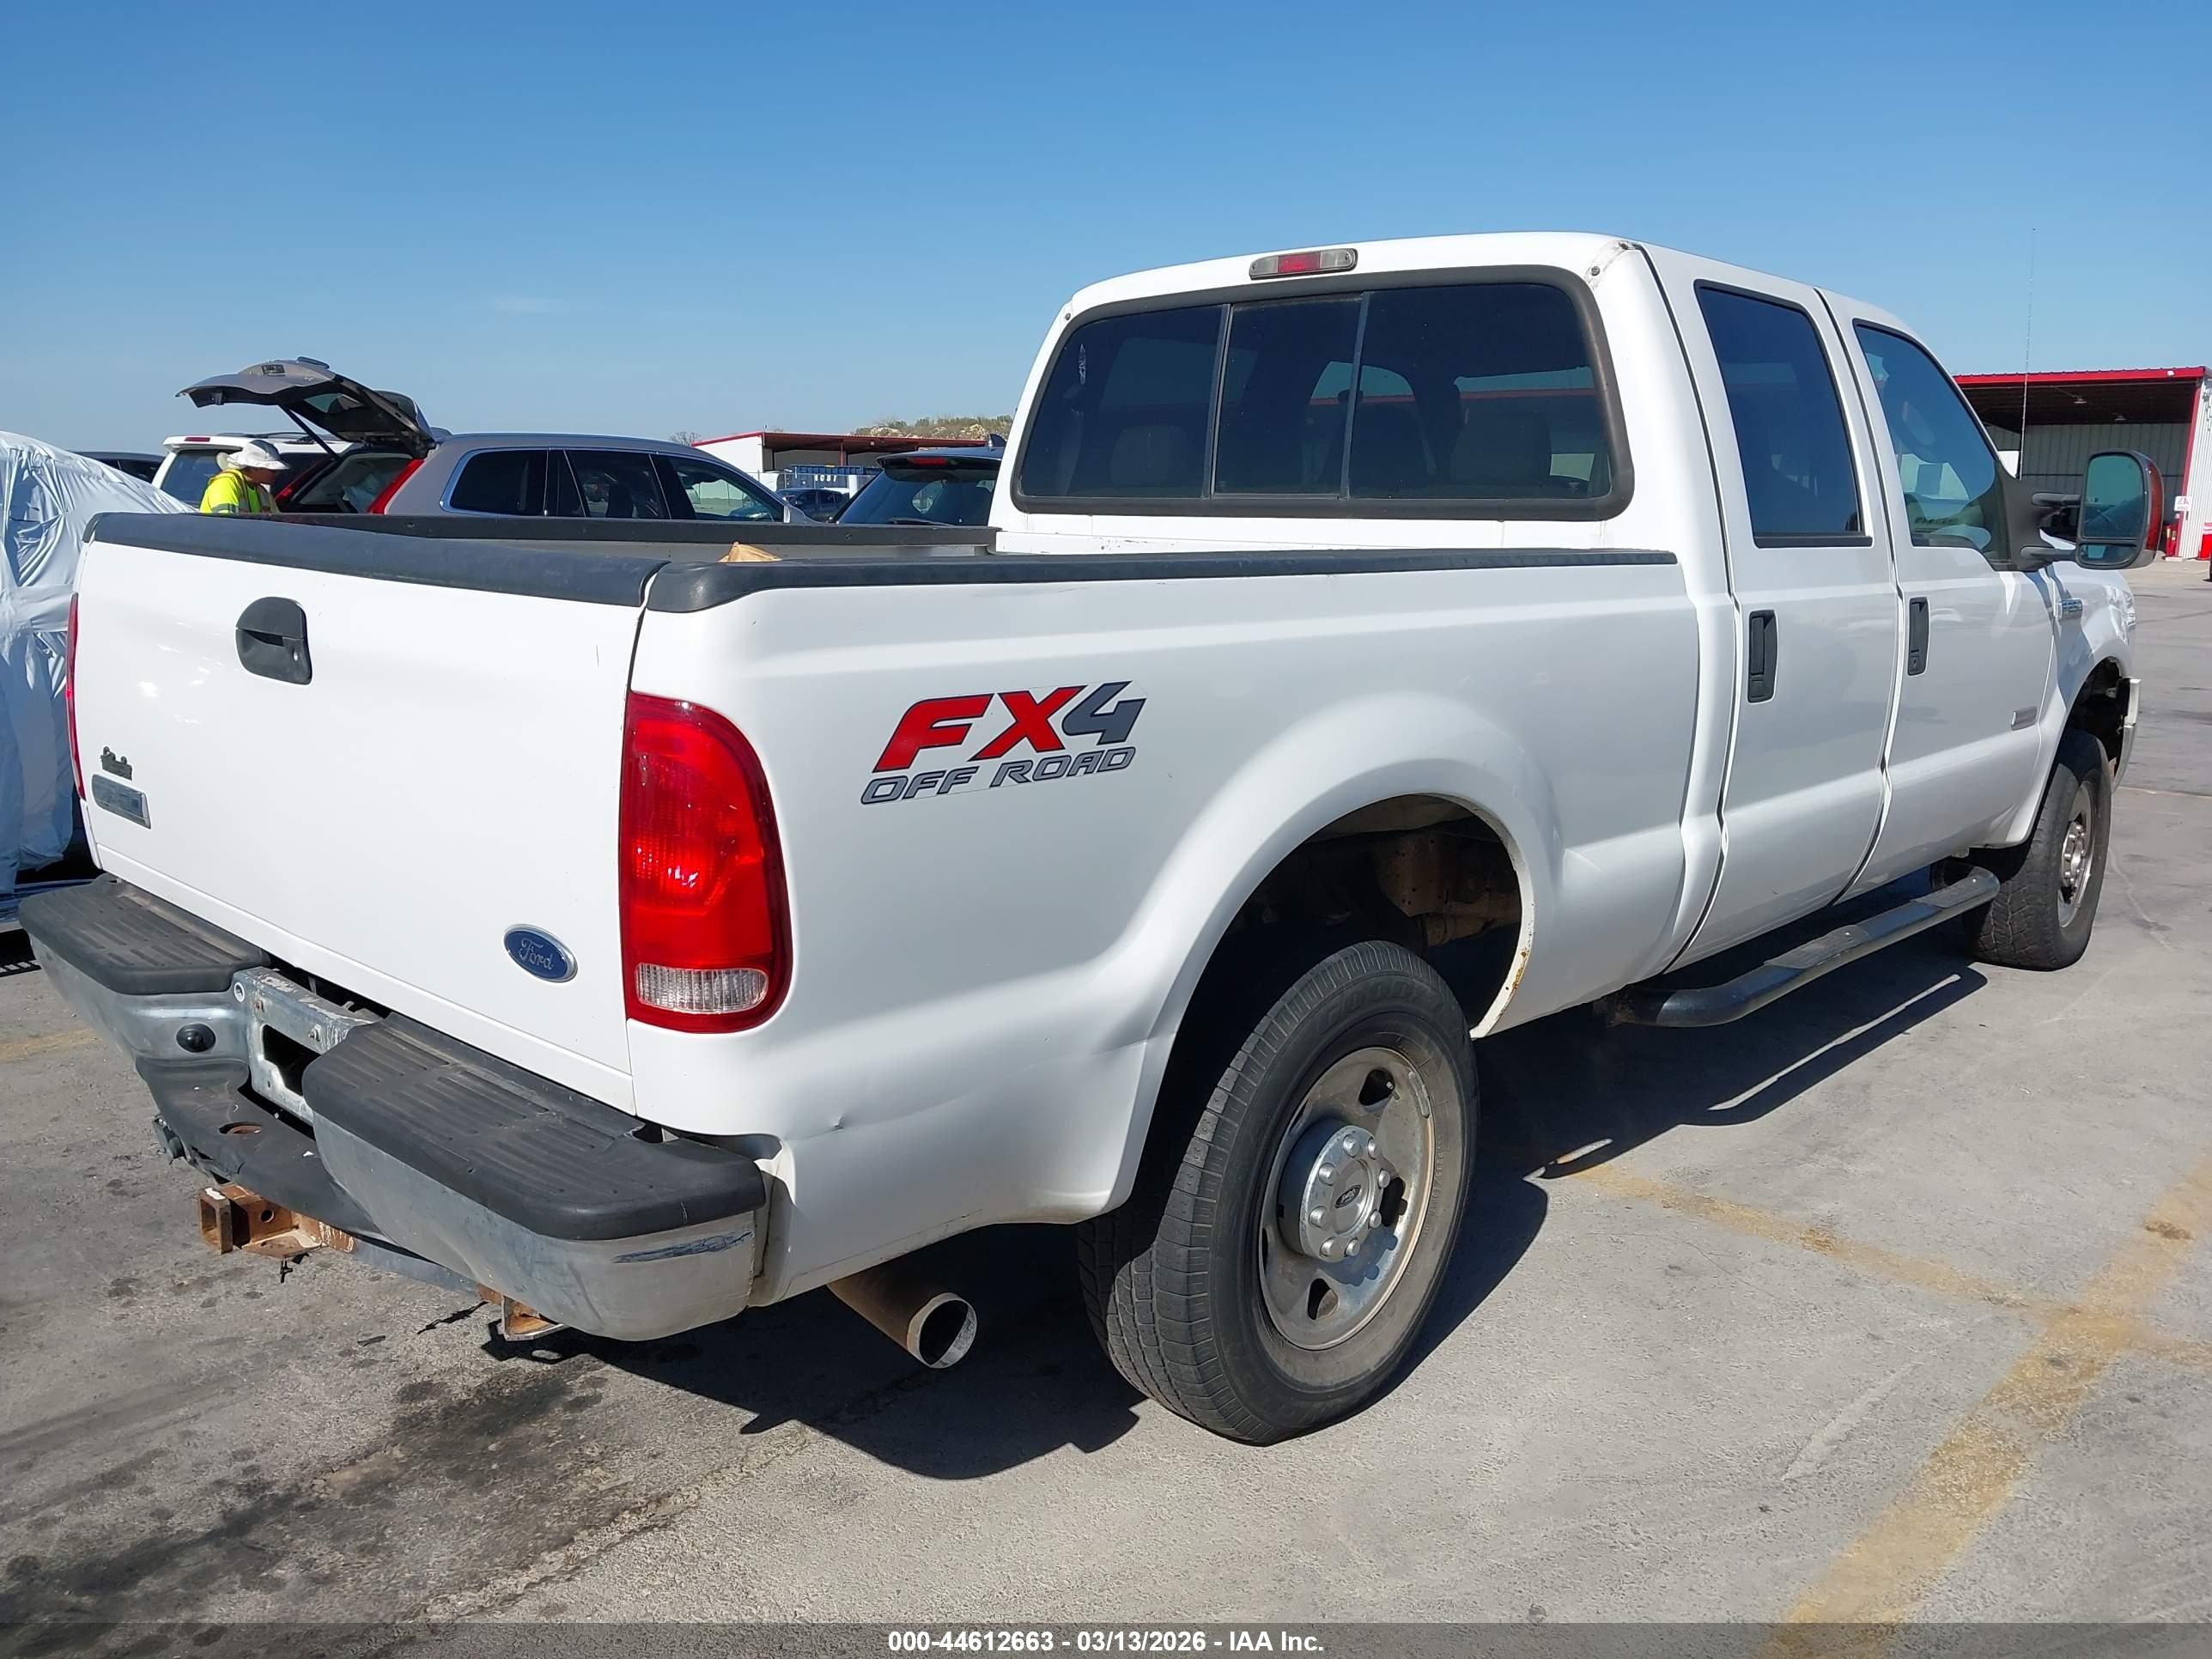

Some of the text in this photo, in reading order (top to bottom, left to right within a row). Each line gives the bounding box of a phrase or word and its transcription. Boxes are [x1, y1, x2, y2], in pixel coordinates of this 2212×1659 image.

[872, 680, 1147, 774] FX4
[860, 746, 1137, 805] OFF ROAD
[519, 937, 555, 970] Ford
